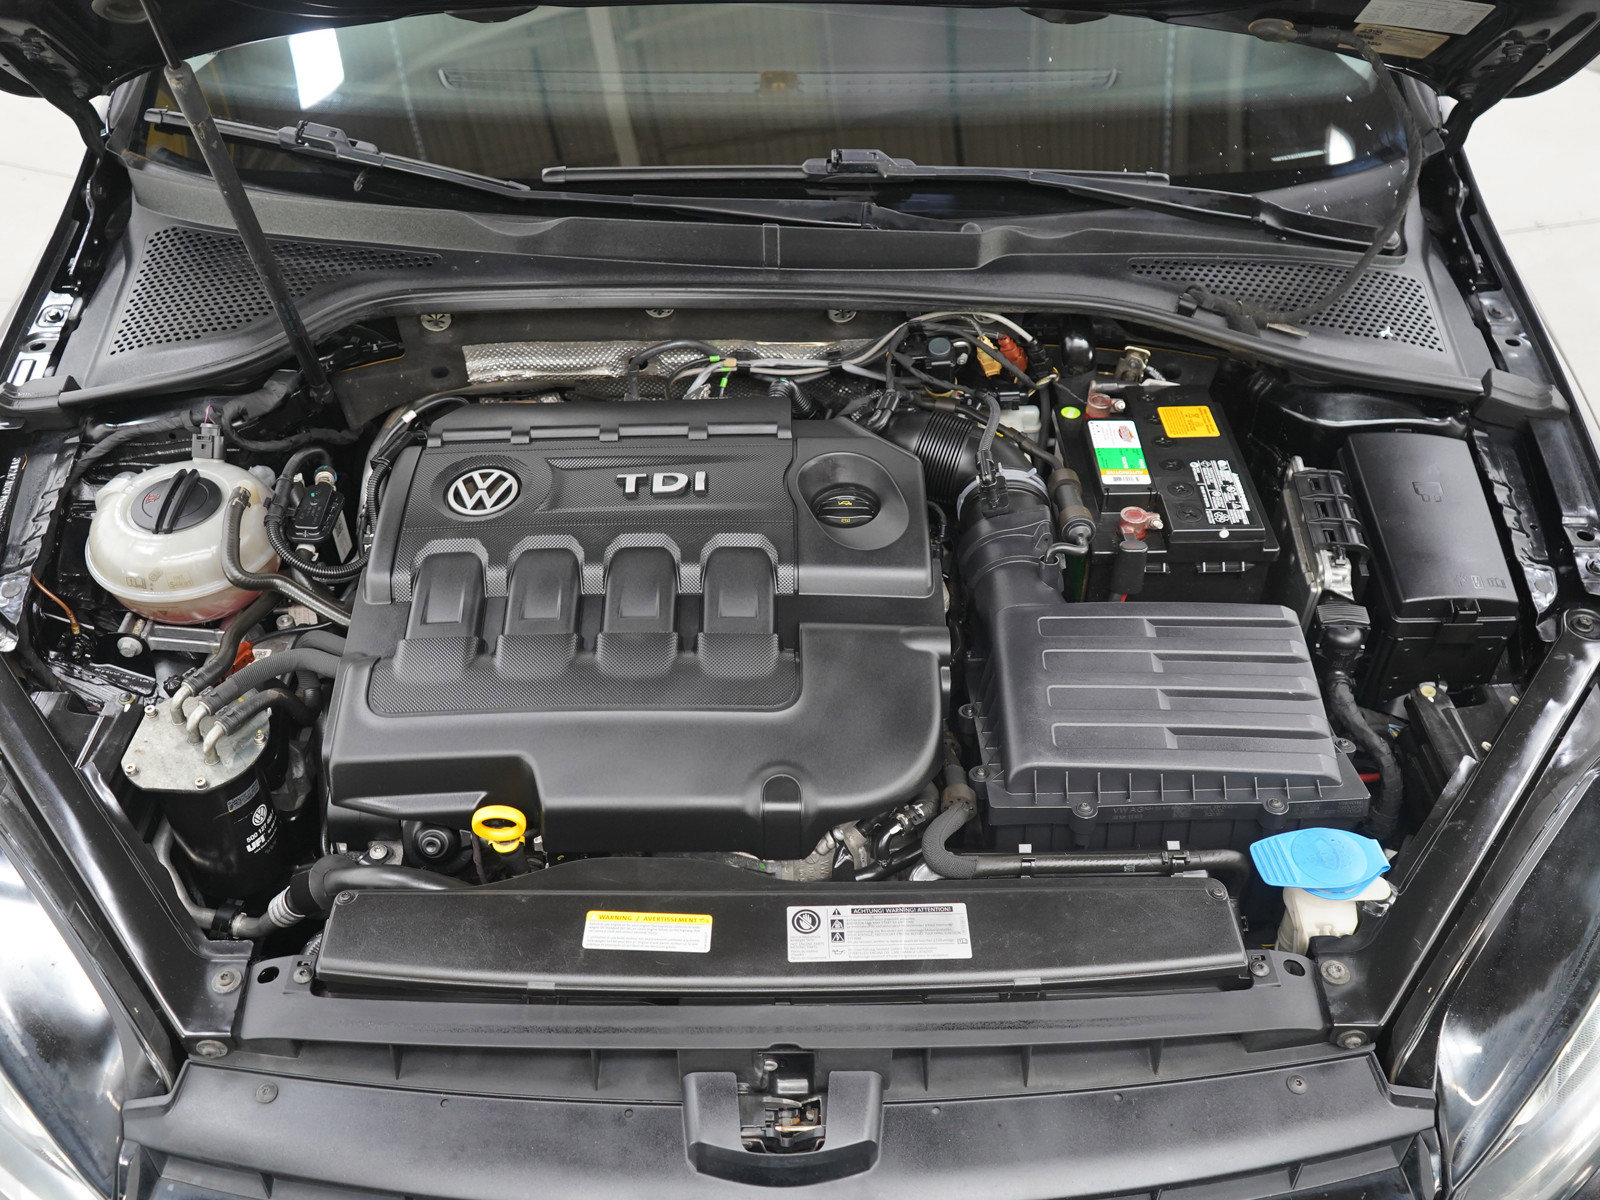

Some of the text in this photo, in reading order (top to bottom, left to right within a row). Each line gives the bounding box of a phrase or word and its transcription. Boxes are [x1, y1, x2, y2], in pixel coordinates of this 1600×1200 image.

[447, 468, 519, 516] VW
[616, 471, 708, 496] TDI
[246, 833, 266, 853] UFI
